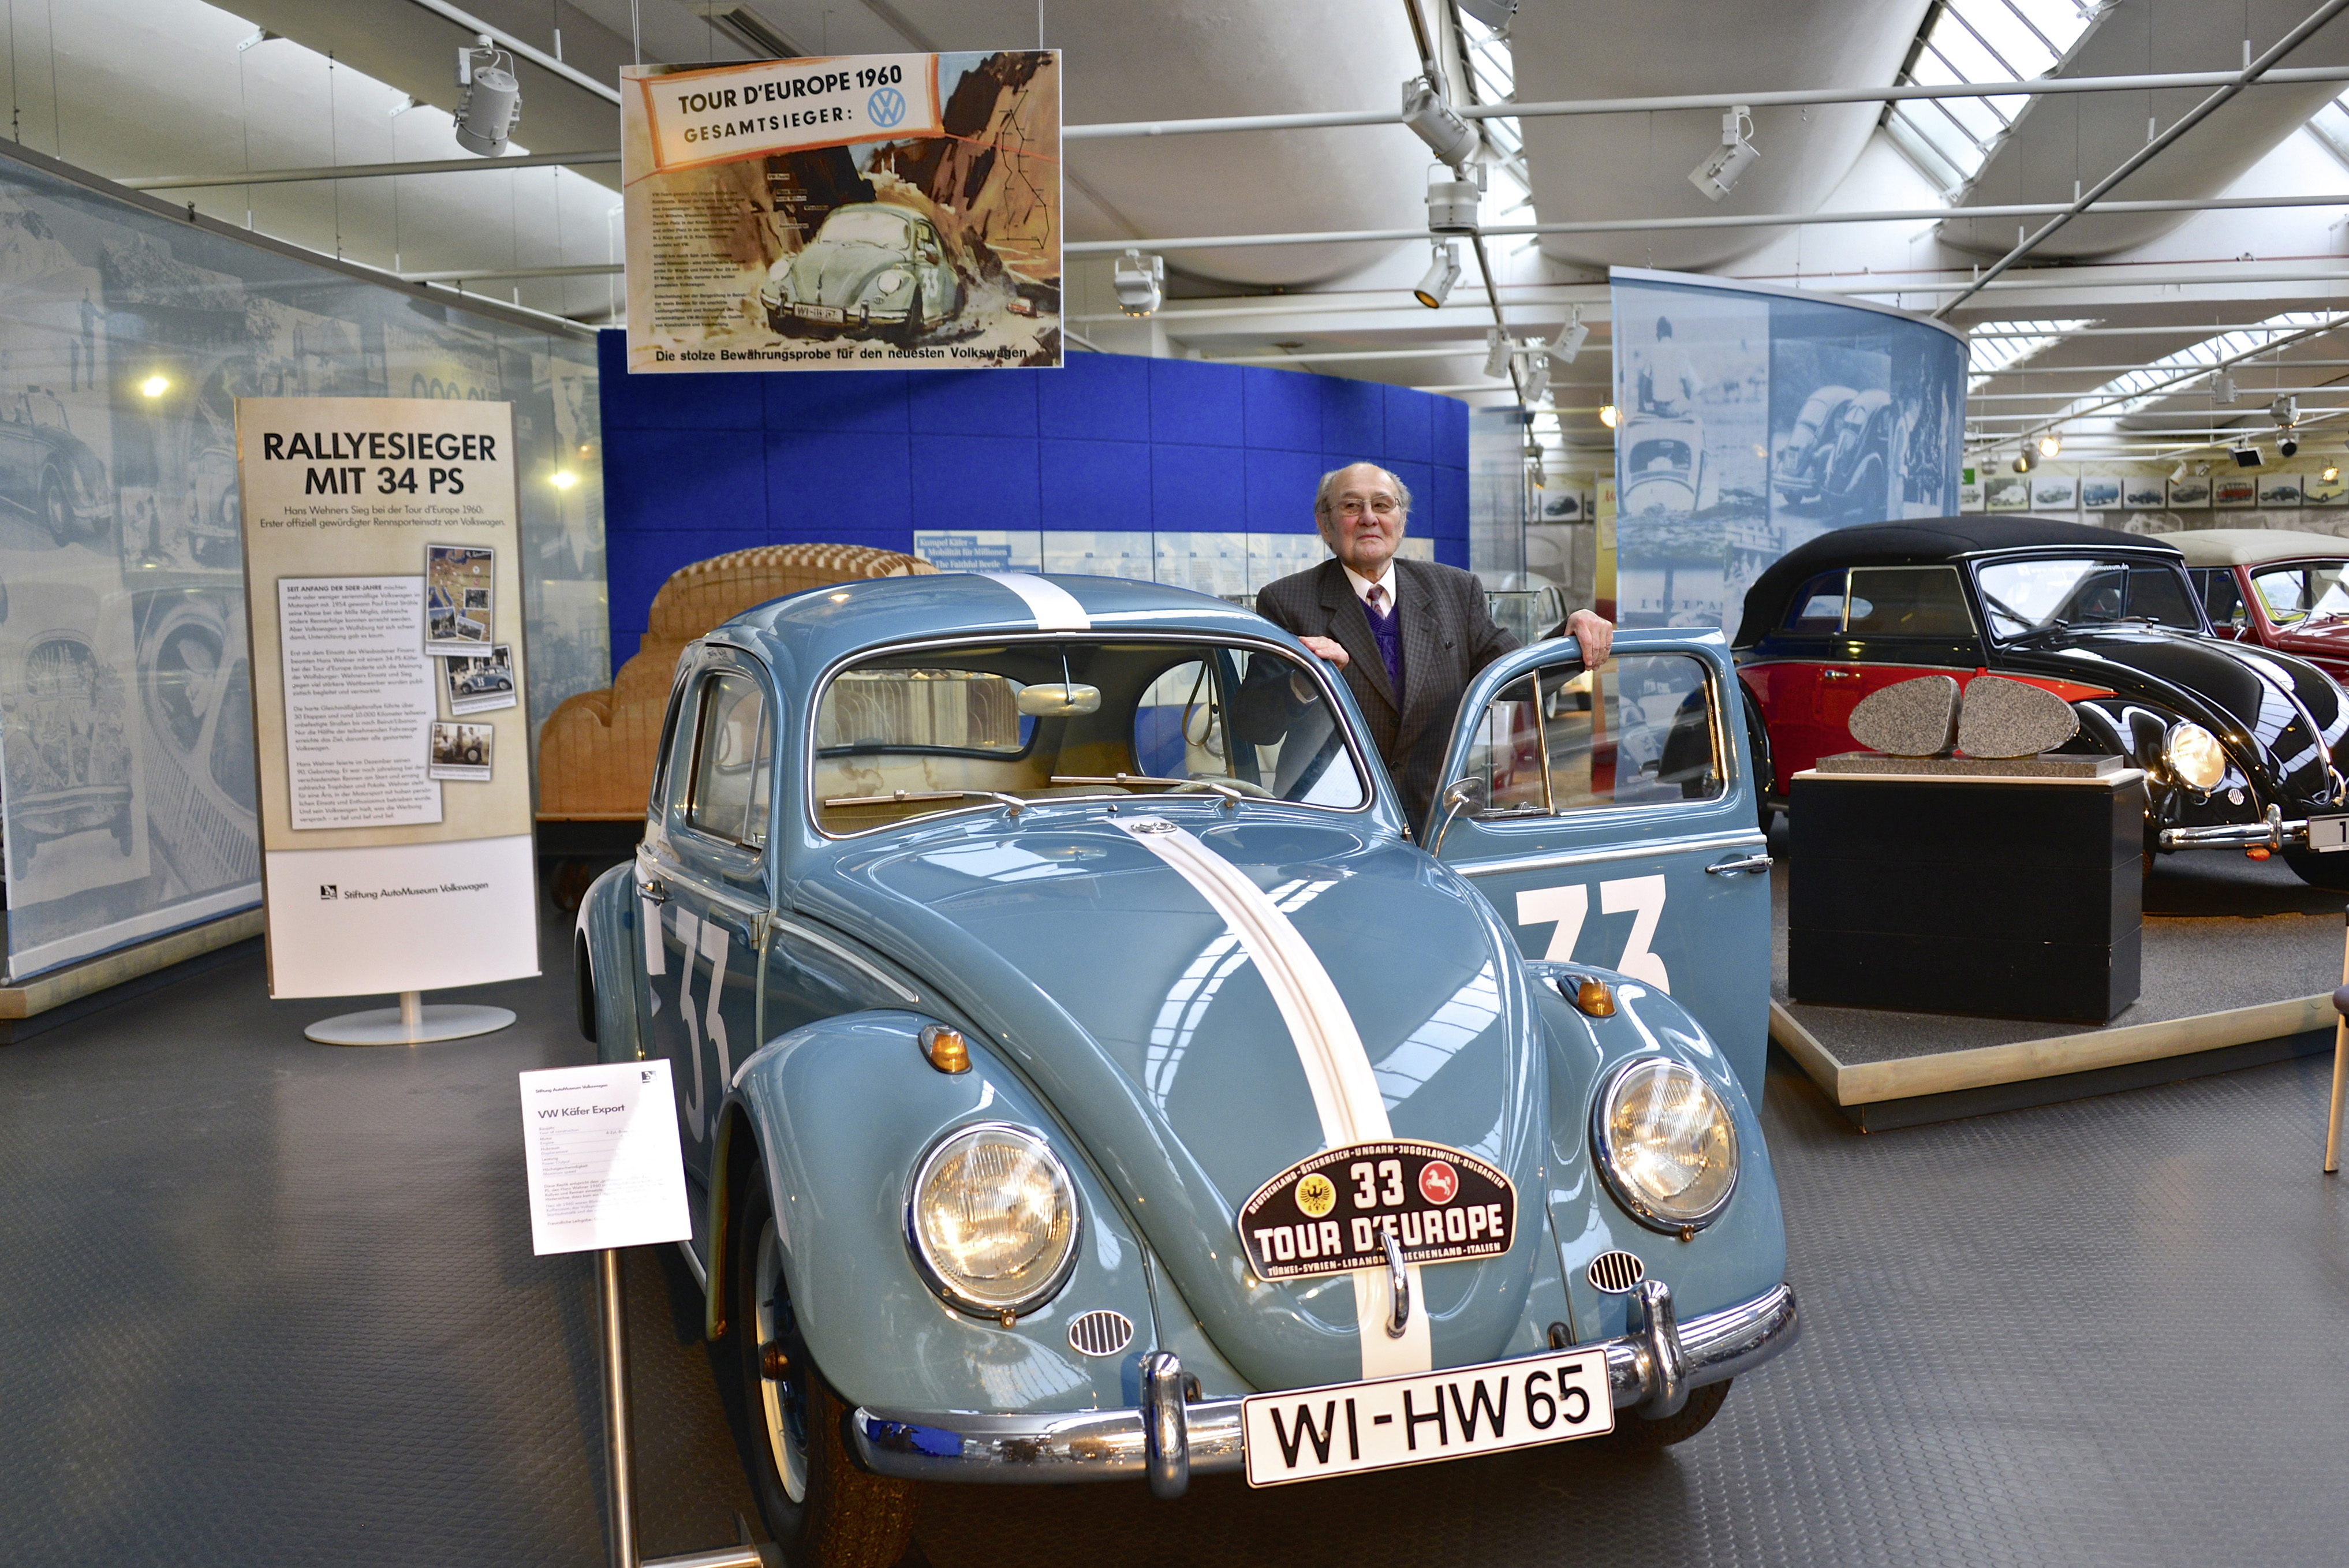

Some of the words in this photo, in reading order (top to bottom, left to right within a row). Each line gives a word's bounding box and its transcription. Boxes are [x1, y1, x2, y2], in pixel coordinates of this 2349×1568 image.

[678, 89, 737, 115] TOUR
[744, 71, 851, 104] D'EUROPE
[856, 64, 902, 88] 1960
[684, 107, 853, 143] GESAMTSIEGER:
[656, 350, 674, 361] Die
[681, 350, 715, 360] stolze
[720, 349, 830, 361] Bewährungsprobe
[837, 347, 853, 359] für
[860, 348, 882, 358] den
[887, 348, 944, 358] neuesten
[951, 346, 1028, 361] Volkswagen
[264, 432, 496, 461] RALLYESIEGER
[305, 467, 366, 494] MIT
[378, 466, 418, 494] 34
[430, 467, 464, 495] PS
[285, 506, 307, 515] Hans
[310, 506, 349, 515] Wehners
[350, 505, 369, 516] Sieg
[372, 505, 385, 513] bei
[387, 505, 403, 513] der
[404, 505, 422, 513] Tour
[260, 519, 283, 528] Erster
[287, 518, 317, 528] offiziell
[319, 518, 370, 528] gewürdigter
[373, 517, 441, 526] Rennsporteinsatz
[950, 538, 968, 546] Käfer
[928, 548, 961, 557] Mobilität
[963, 548, 973, 557] für
[974, 548, 1007, 556] Millionen
[951, 559, 978, 568] Faithful
[344, 889, 378, 901] Stiftung
[380, 886, 438, 897] AutoMuseum
[440, 882, 488, 892] Volkswagen
[538, 1109, 558, 1118] VW
[562, 1106, 589, 1116] Käfer
[592, 1104, 624, 1114] Export
[1350, 1159, 1405, 1209] 33
[1254, 1220, 1343, 1263] TOUR
[1351, 1203, 1504, 1253] D'EUROPE
[1524, 1364, 1590, 1430] 65
